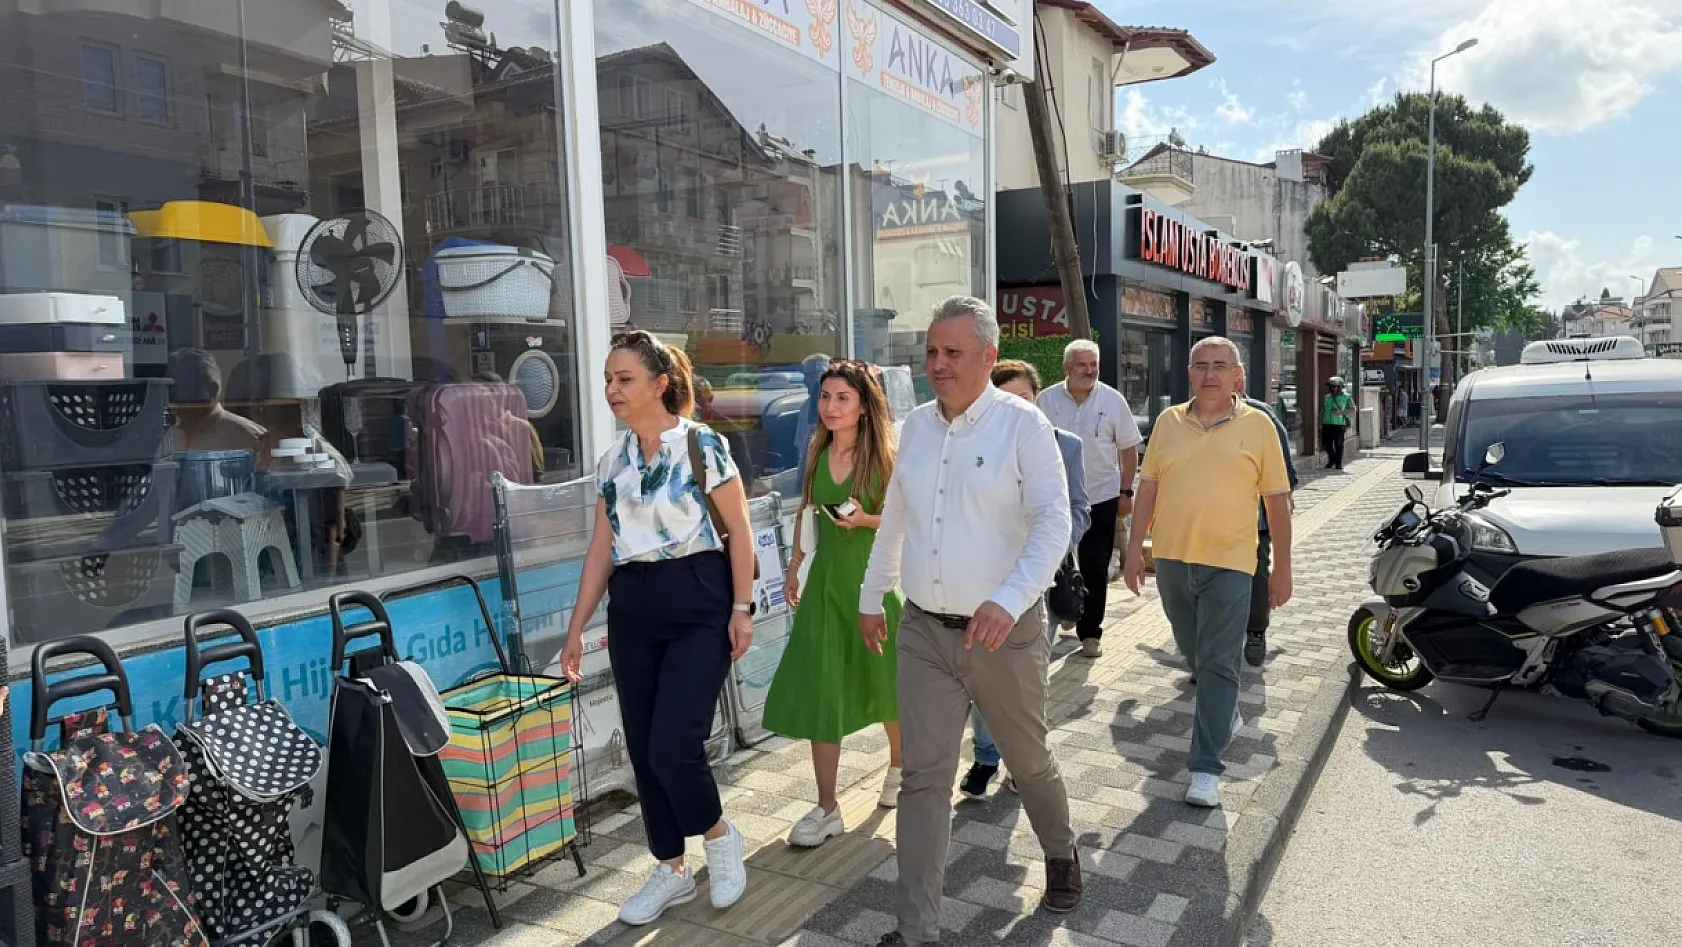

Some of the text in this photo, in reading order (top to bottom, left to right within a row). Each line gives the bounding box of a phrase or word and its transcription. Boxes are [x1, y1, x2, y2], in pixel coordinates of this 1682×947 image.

[887, 24, 956, 100] ANKA
[1181, 222, 1207, 278] USTA
[1002, 293, 1070, 329] USTA
